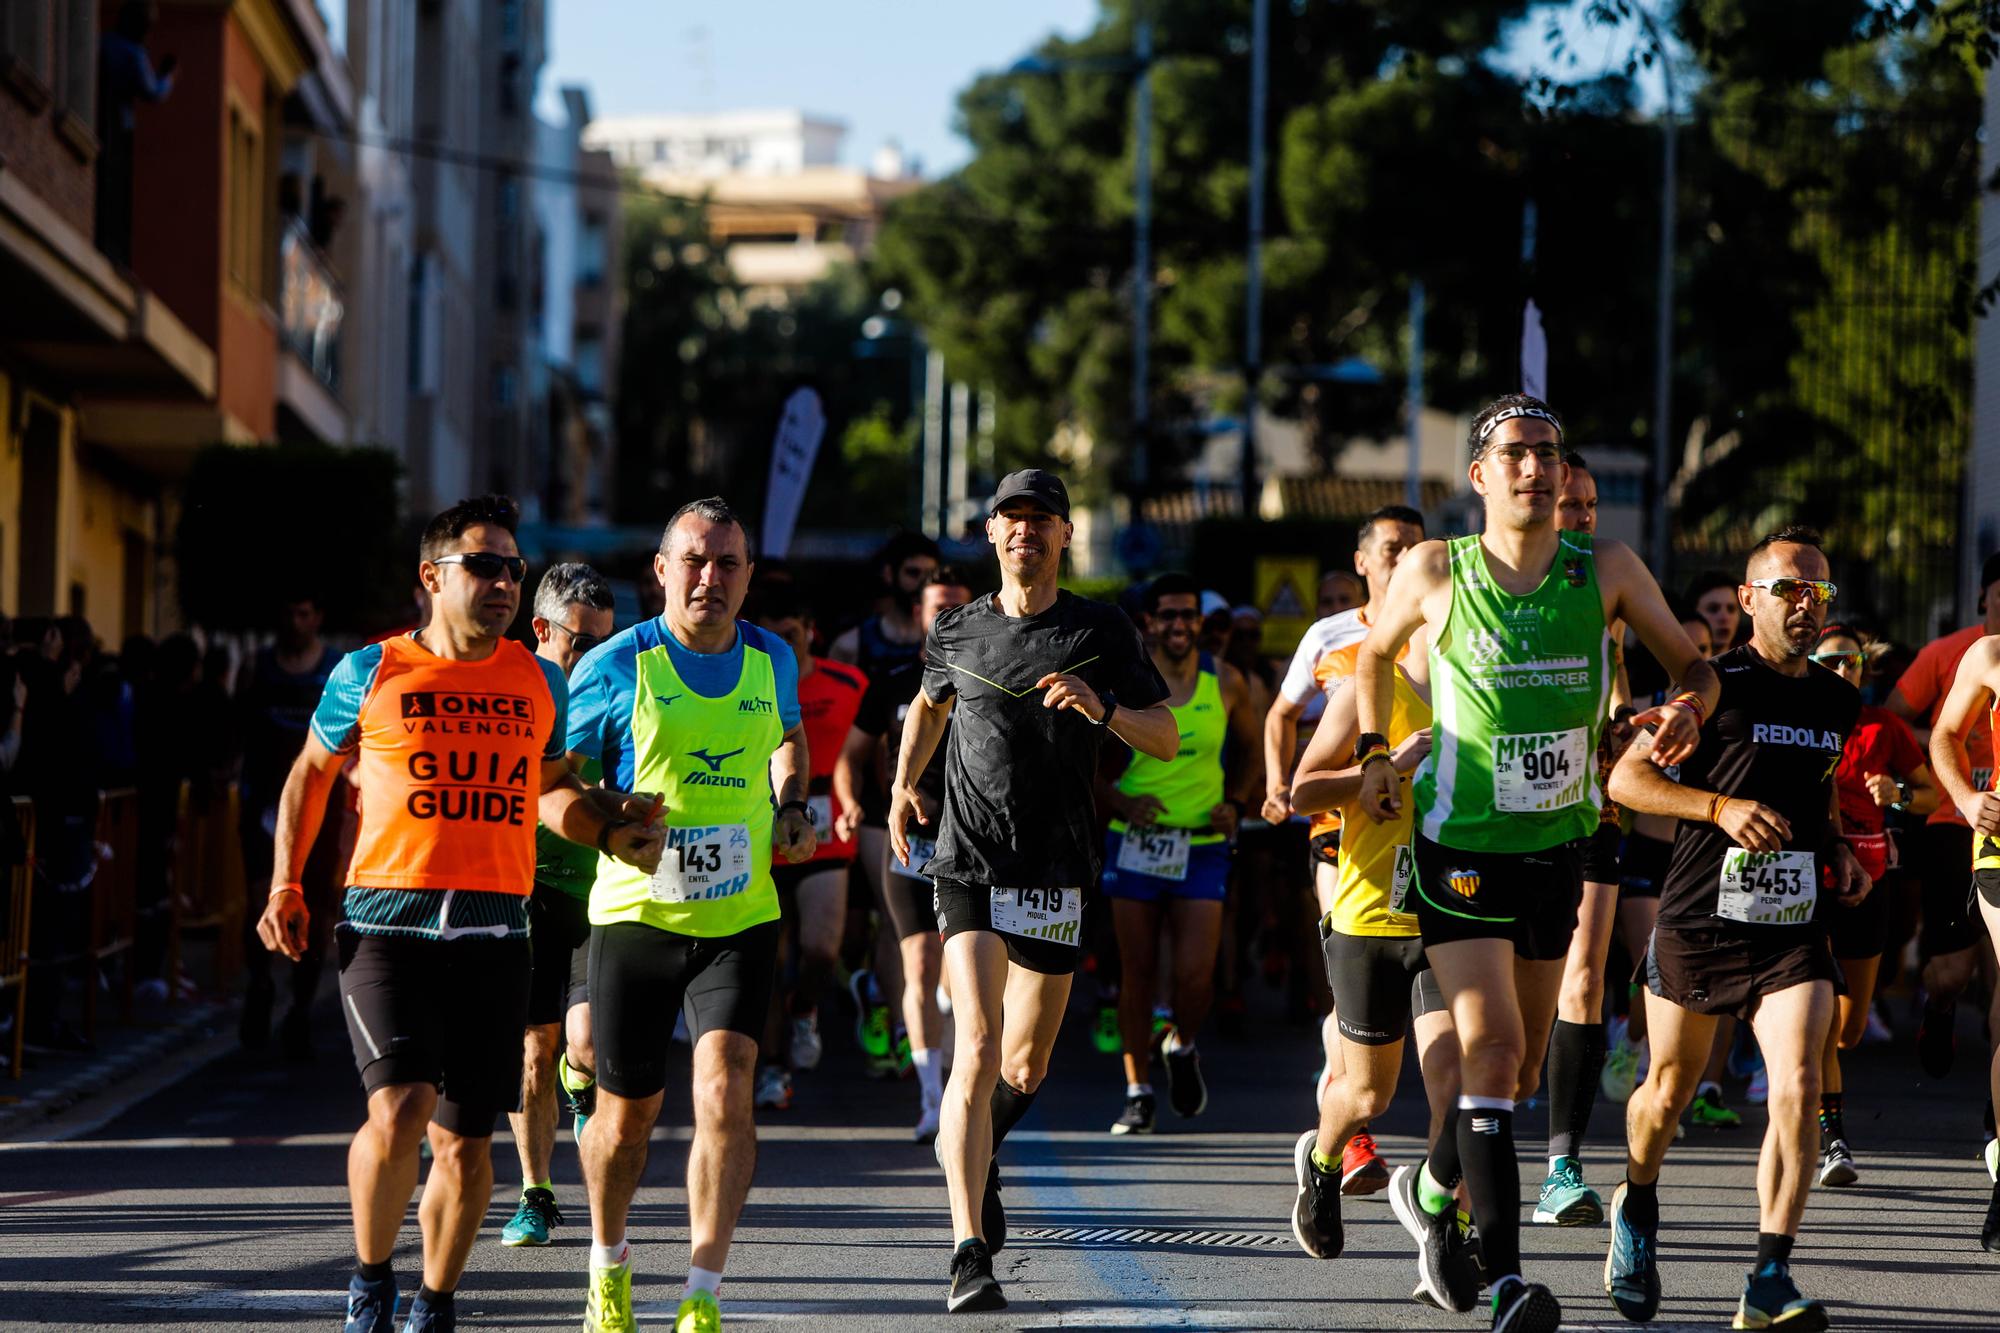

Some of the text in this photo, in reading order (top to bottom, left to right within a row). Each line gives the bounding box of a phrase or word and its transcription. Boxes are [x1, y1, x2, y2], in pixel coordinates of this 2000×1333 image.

[1480, 406, 1562, 439] adida
[441, 696, 529, 718] ONCE
[404, 720, 534, 739] VALENCIA
[408, 751, 528, 787] GUIA
[1522, 749, 1570, 780] 904
[407, 789, 526, 826] GUIDE
[677, 844, 721, 872] 143
[688, 874, 710, 883] ENYEL
[1741, 866, 1801, 896] 5453
[1017, 887, 1063, 913] 1419
[1760, 896, 1782, 905] PEDRO
[1026, 911, 1048, 921] MIQUEL
